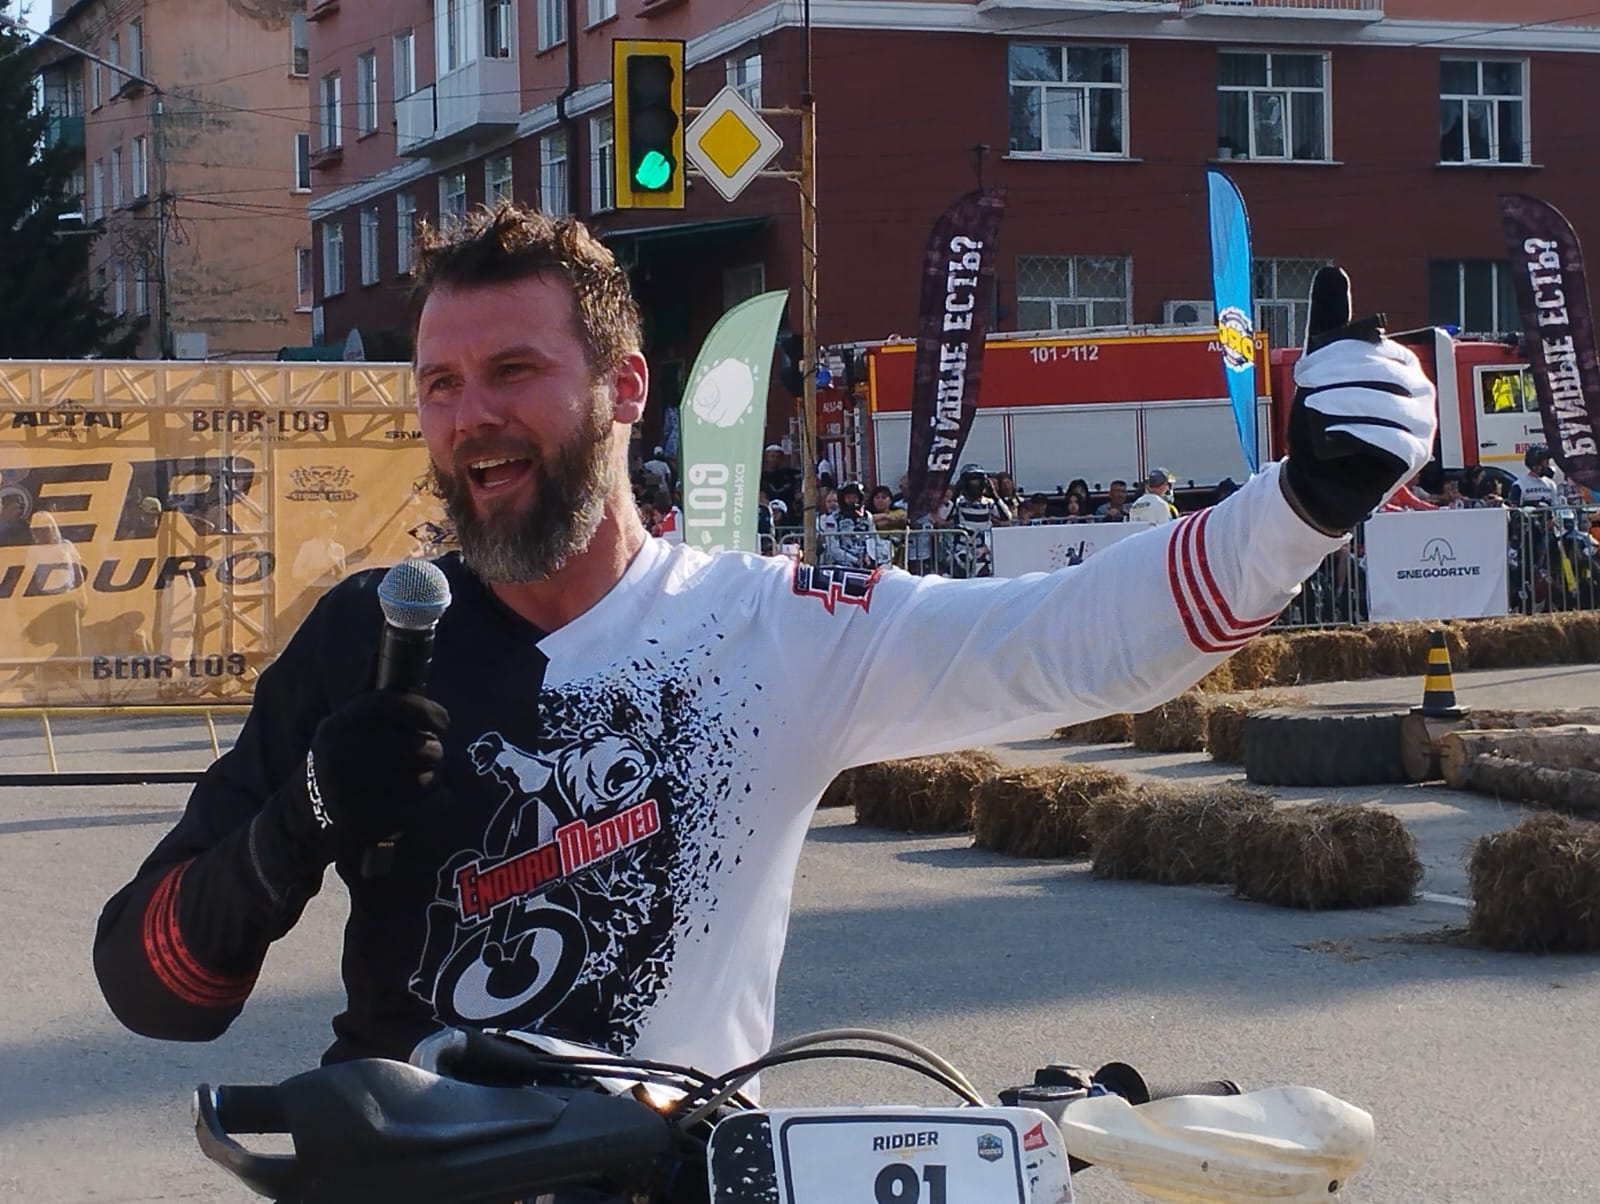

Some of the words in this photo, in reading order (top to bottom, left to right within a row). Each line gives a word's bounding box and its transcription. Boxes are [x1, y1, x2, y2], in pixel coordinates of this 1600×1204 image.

[943, 235, 983, 332] ЕСТЬ?
[1524, 237, 1569, 328] ЕСТЬ?
[1030, 347, 1057, 364] 101
[1071, 345, 1099, 361] 112
[12, 410, 122, 429] ALTAI
[1543, 335, 1597, 460] БУЙНЫЕ
[1397, 566, 1481, 579] SNEGODRIVE
[557, 800, 658, 876] MEDVED
[873, 1131, 939, 1151] RIDDER
